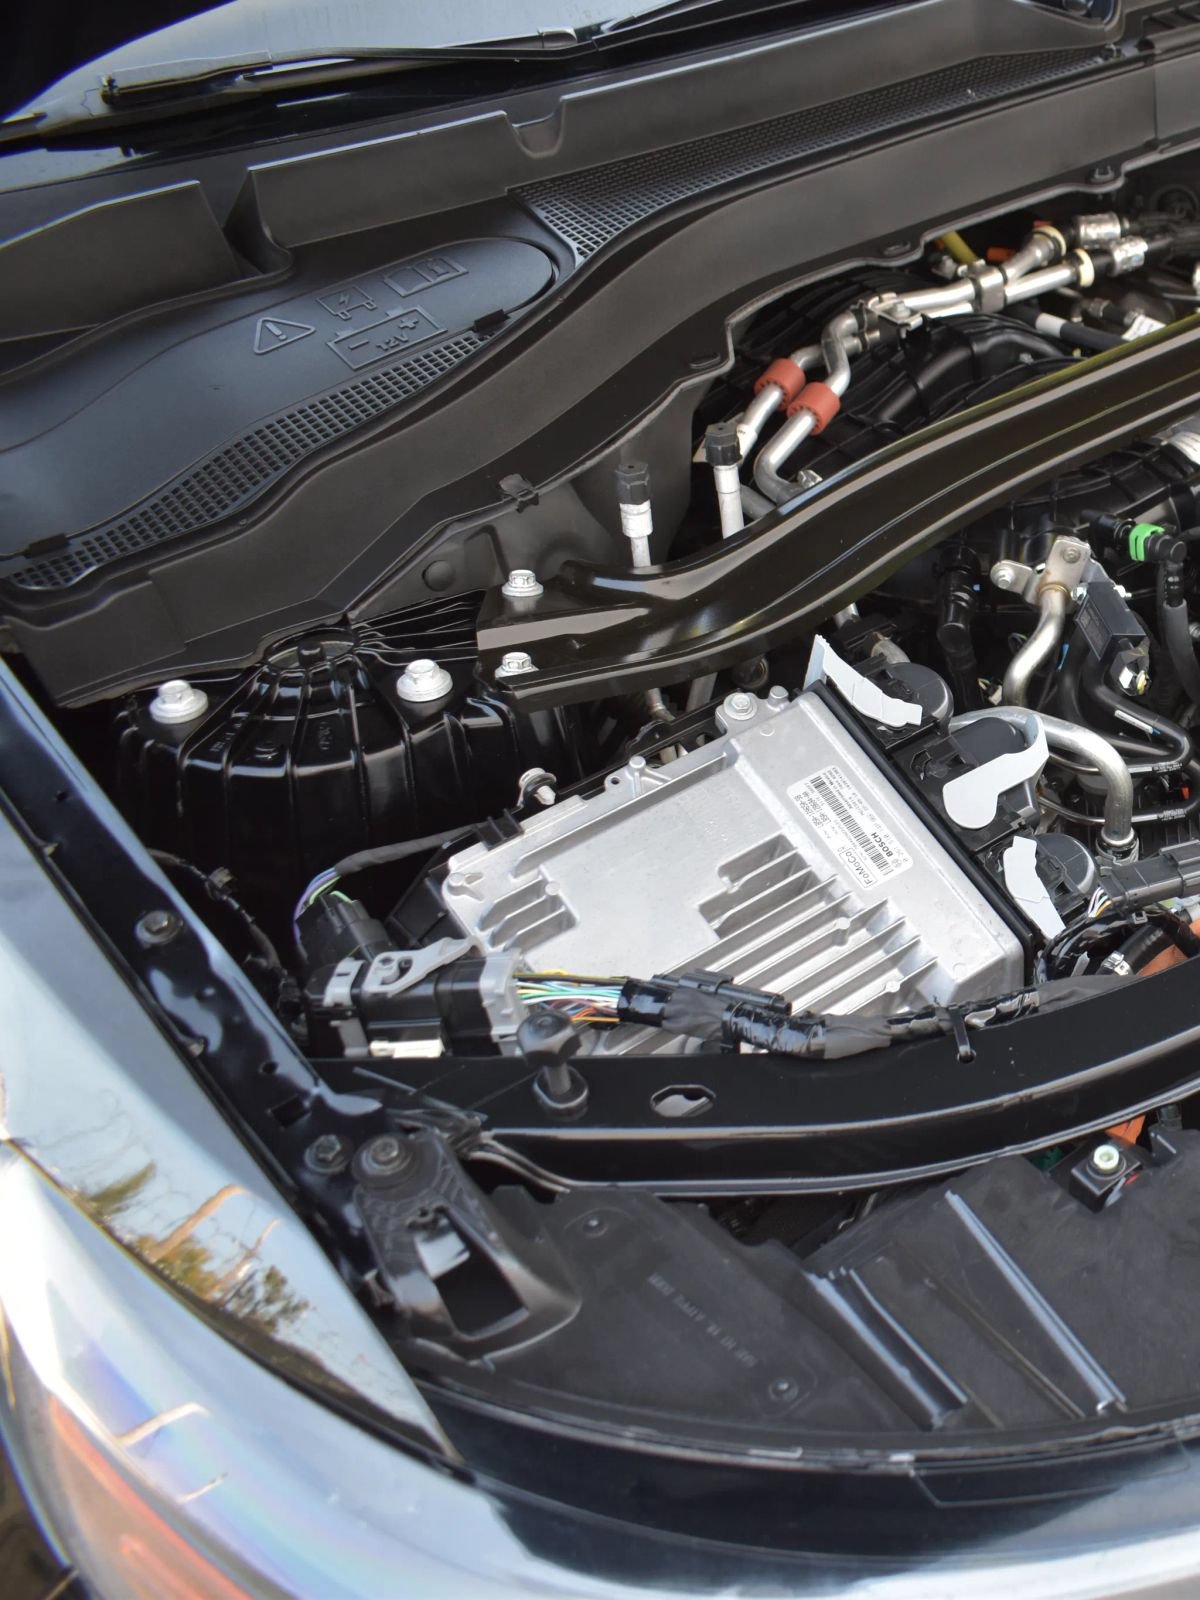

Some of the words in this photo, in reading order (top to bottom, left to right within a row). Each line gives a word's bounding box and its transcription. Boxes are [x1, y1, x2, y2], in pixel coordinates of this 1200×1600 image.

[376, 332, 409, 351] 12V
[869, 831, 893, 857] BOSCH
[842, 850, 873, 884] FoMaCo
